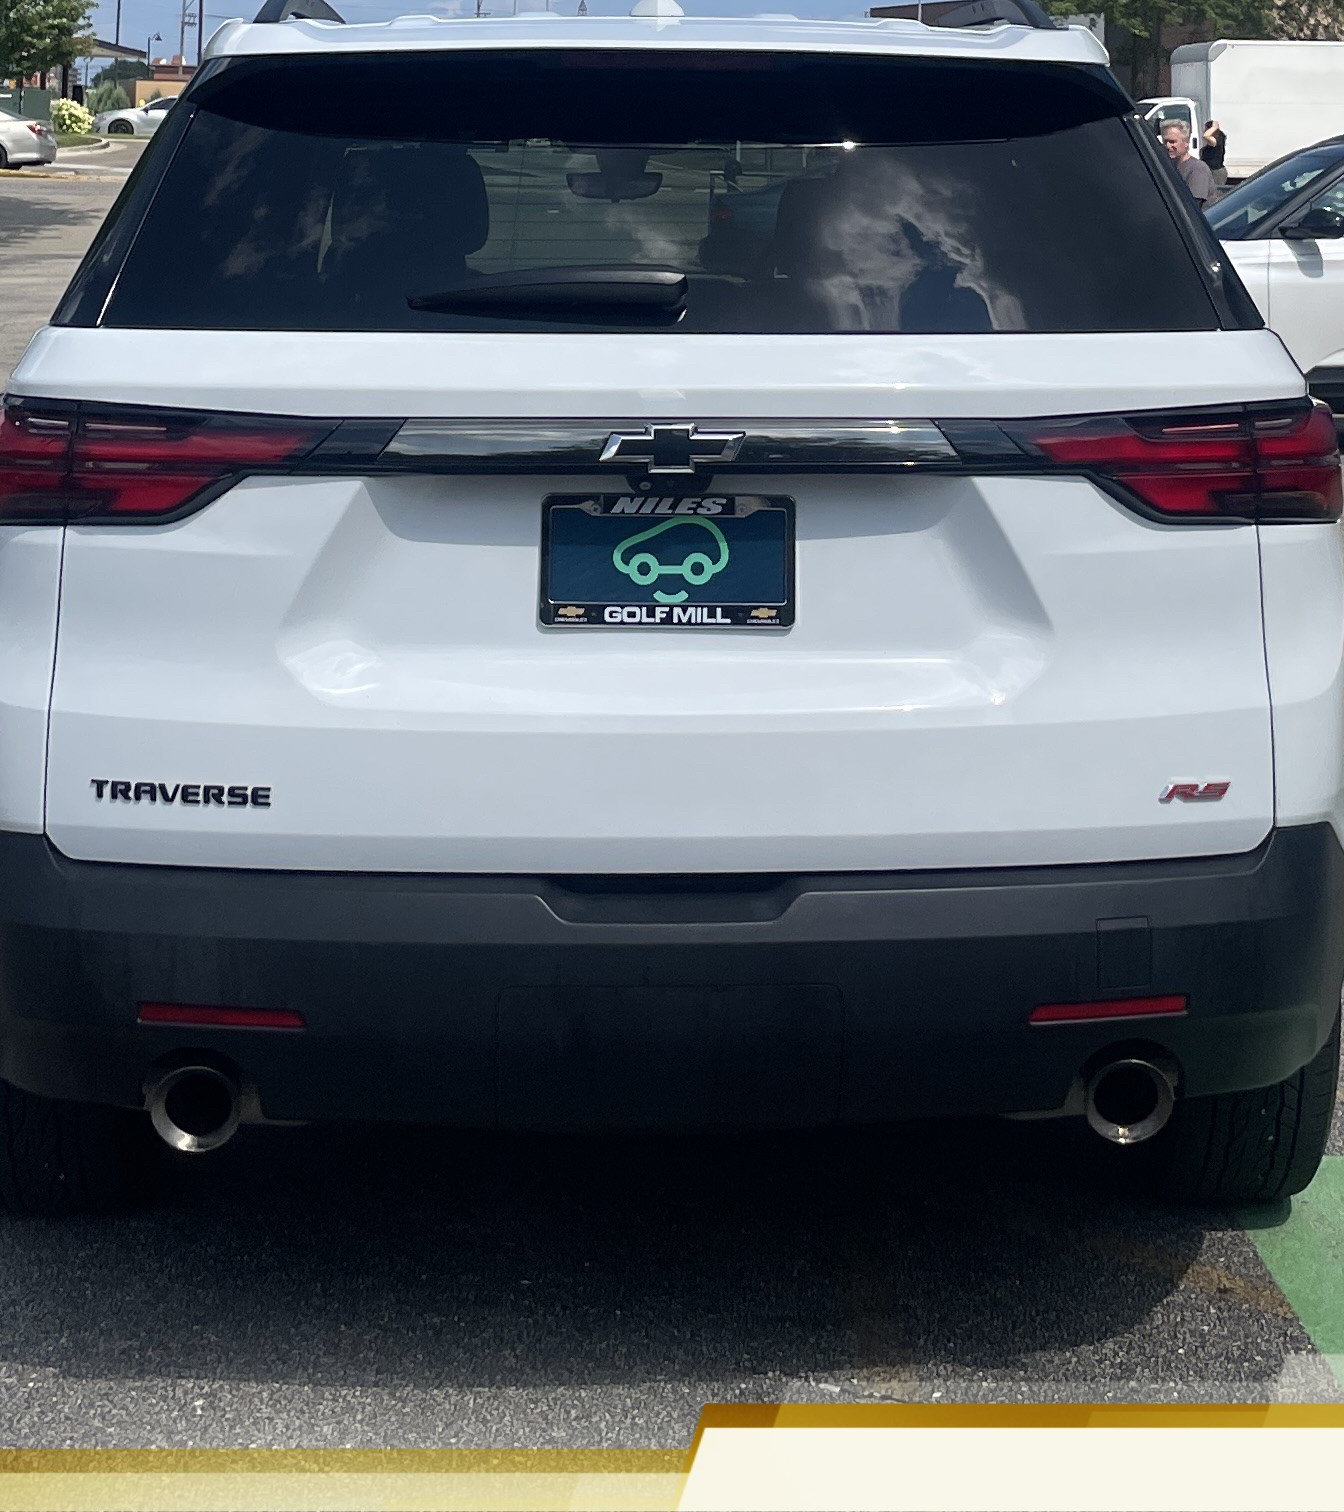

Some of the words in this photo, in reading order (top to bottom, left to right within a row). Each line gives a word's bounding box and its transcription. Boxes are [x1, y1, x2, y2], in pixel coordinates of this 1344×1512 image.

[611, 497, 727, 515] NILES
[604, 606, 670, 624] GOLF
[672, 606, 732, 624] MILL
[90, 778, 273, 808] TRAVERSE
[1158, 780, 1232, 805] RS
